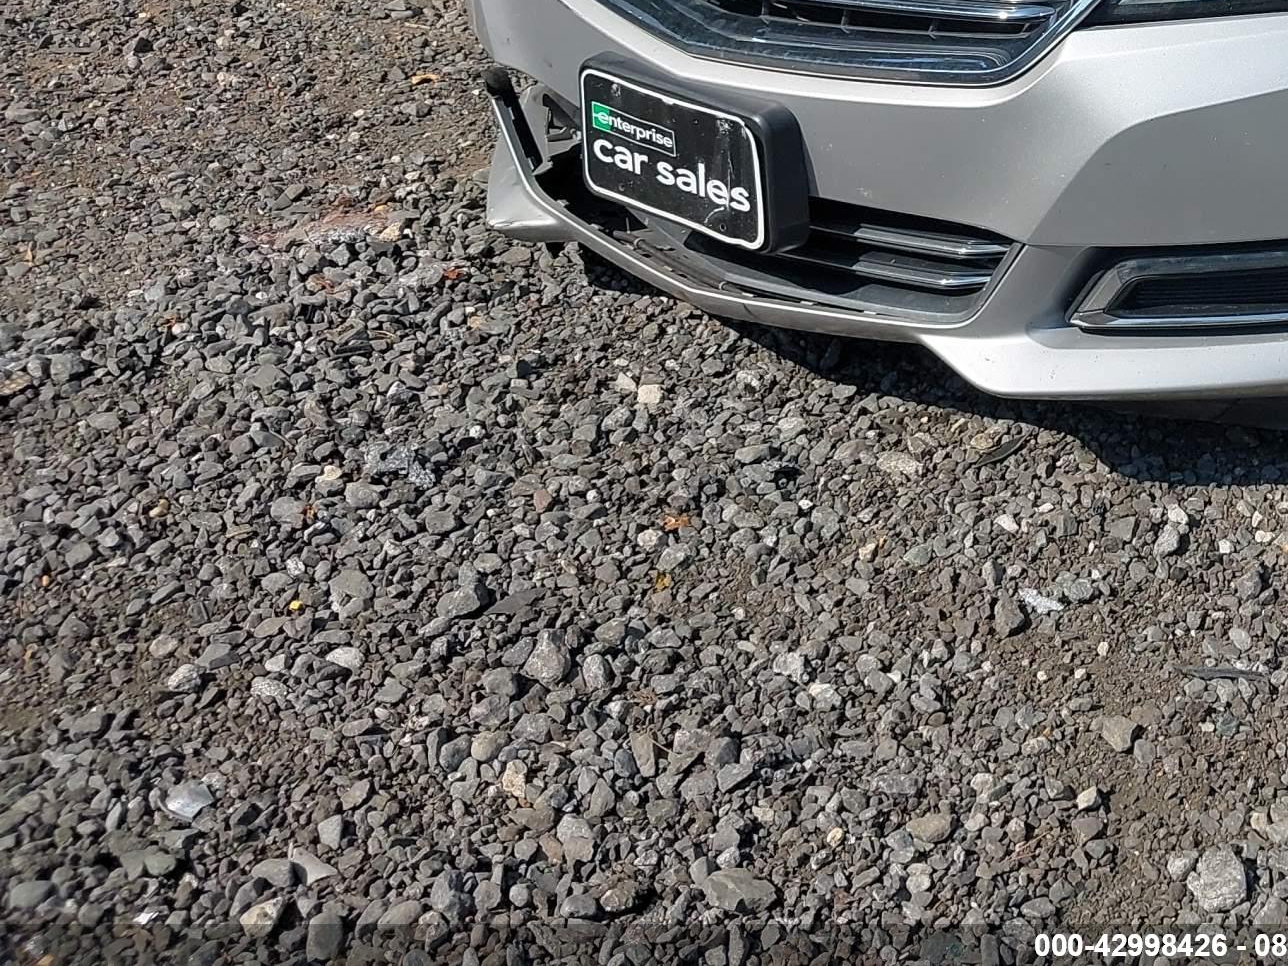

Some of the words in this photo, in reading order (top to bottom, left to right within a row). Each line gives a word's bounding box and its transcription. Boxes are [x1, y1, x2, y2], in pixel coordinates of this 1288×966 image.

[594, 111, 673, 149] enterprise
[593, 139, 649, 176] car
[656, 161, 751, 212] sales
